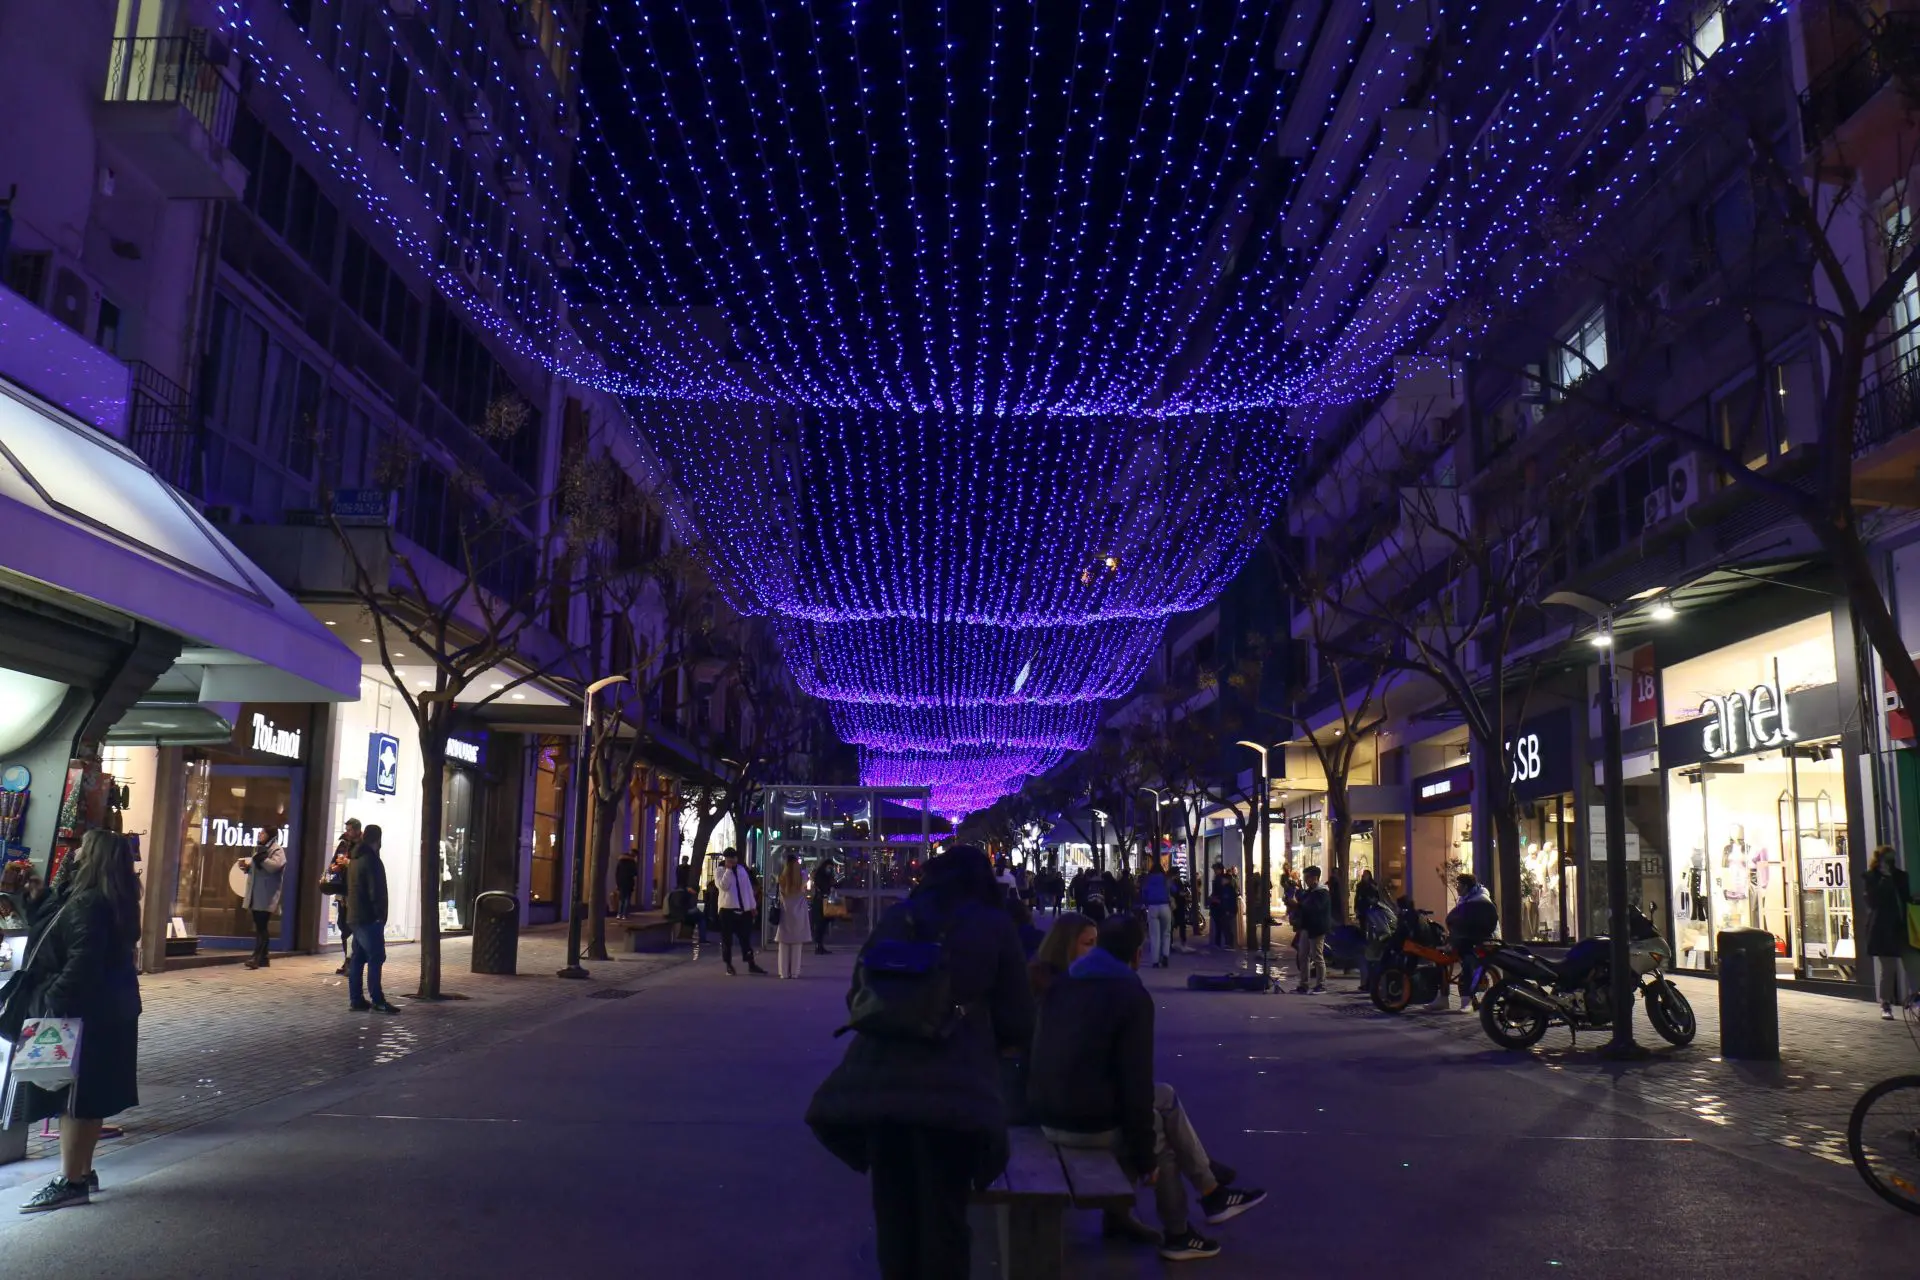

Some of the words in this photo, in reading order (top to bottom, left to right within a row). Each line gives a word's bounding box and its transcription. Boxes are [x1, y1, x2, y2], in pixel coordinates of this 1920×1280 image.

[1637, 672, 1655, 702] 18
[1699, 656, 1789, 756] anel
[252, 712, 301, 759] Toi&moi
